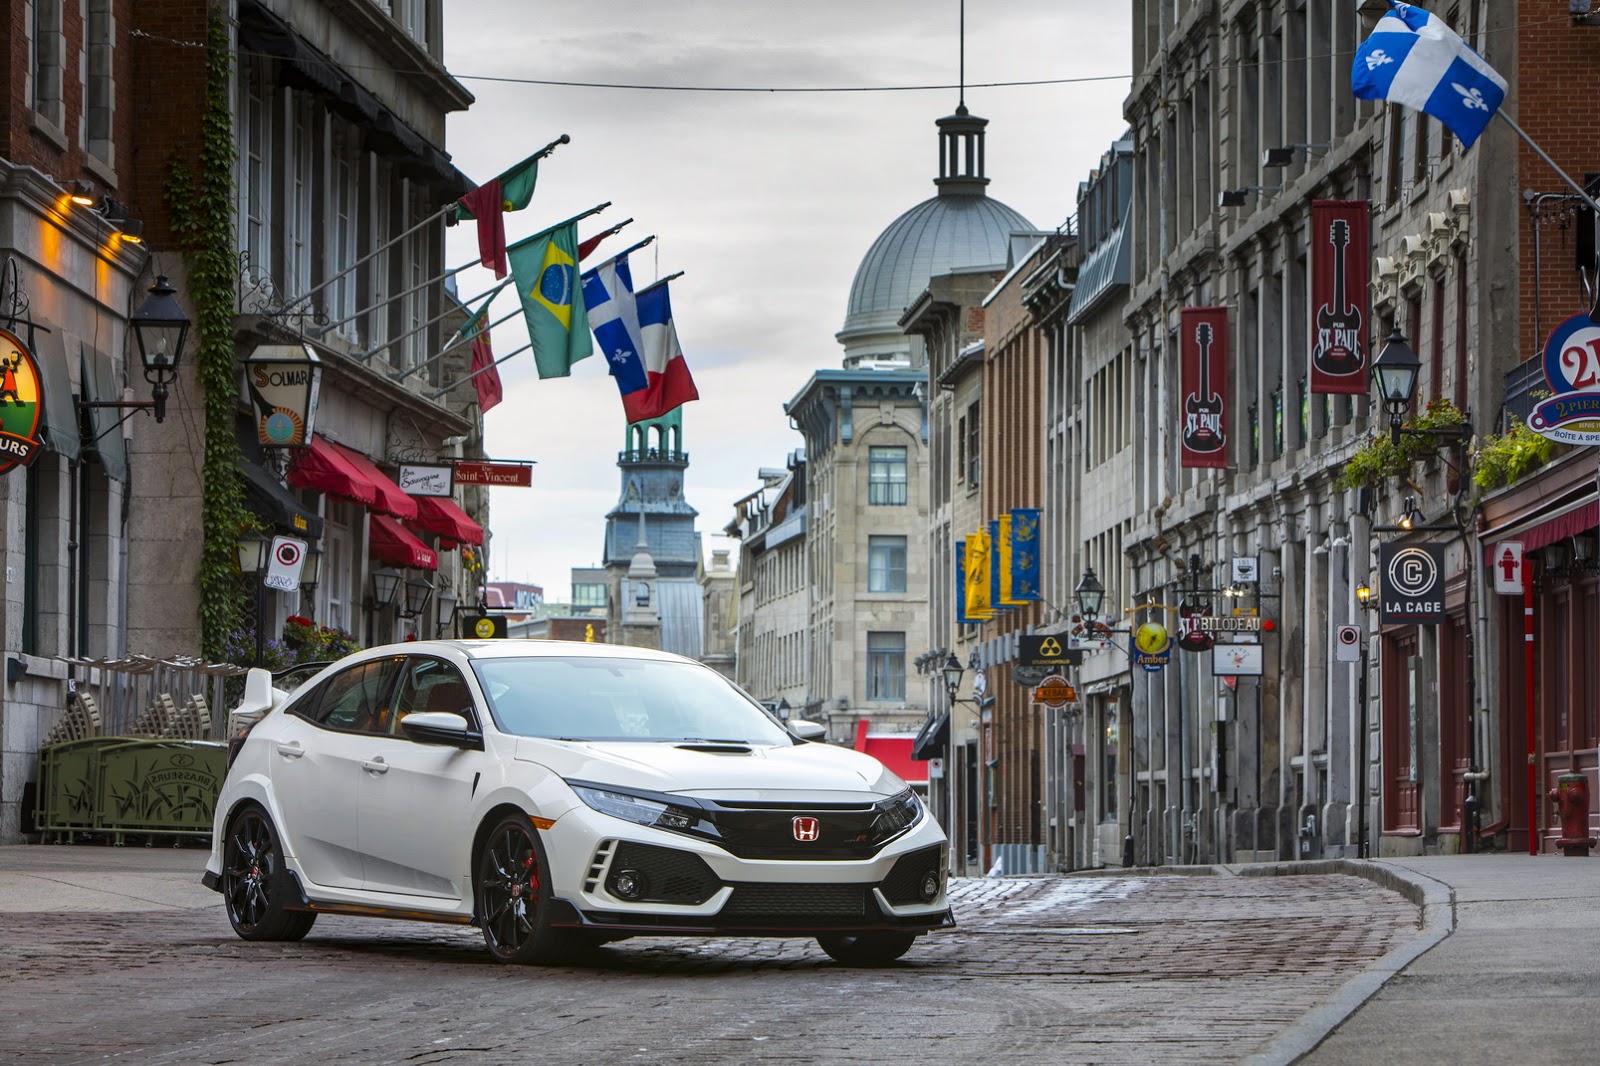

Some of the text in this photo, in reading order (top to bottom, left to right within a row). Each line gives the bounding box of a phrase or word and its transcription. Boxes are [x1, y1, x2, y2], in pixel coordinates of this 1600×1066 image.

[1318, 328, 1360, 361] ST. PAUL
[1187, 412, 1222, 440] ST. PAUL
[455, 470, 519, 483] Saint-Vincent
[1386, 602, 1441, 613] LA CAGE
[1201, 617, 1260, 631] BILODEAU
[1137, 654, 1168, 664] Amber
